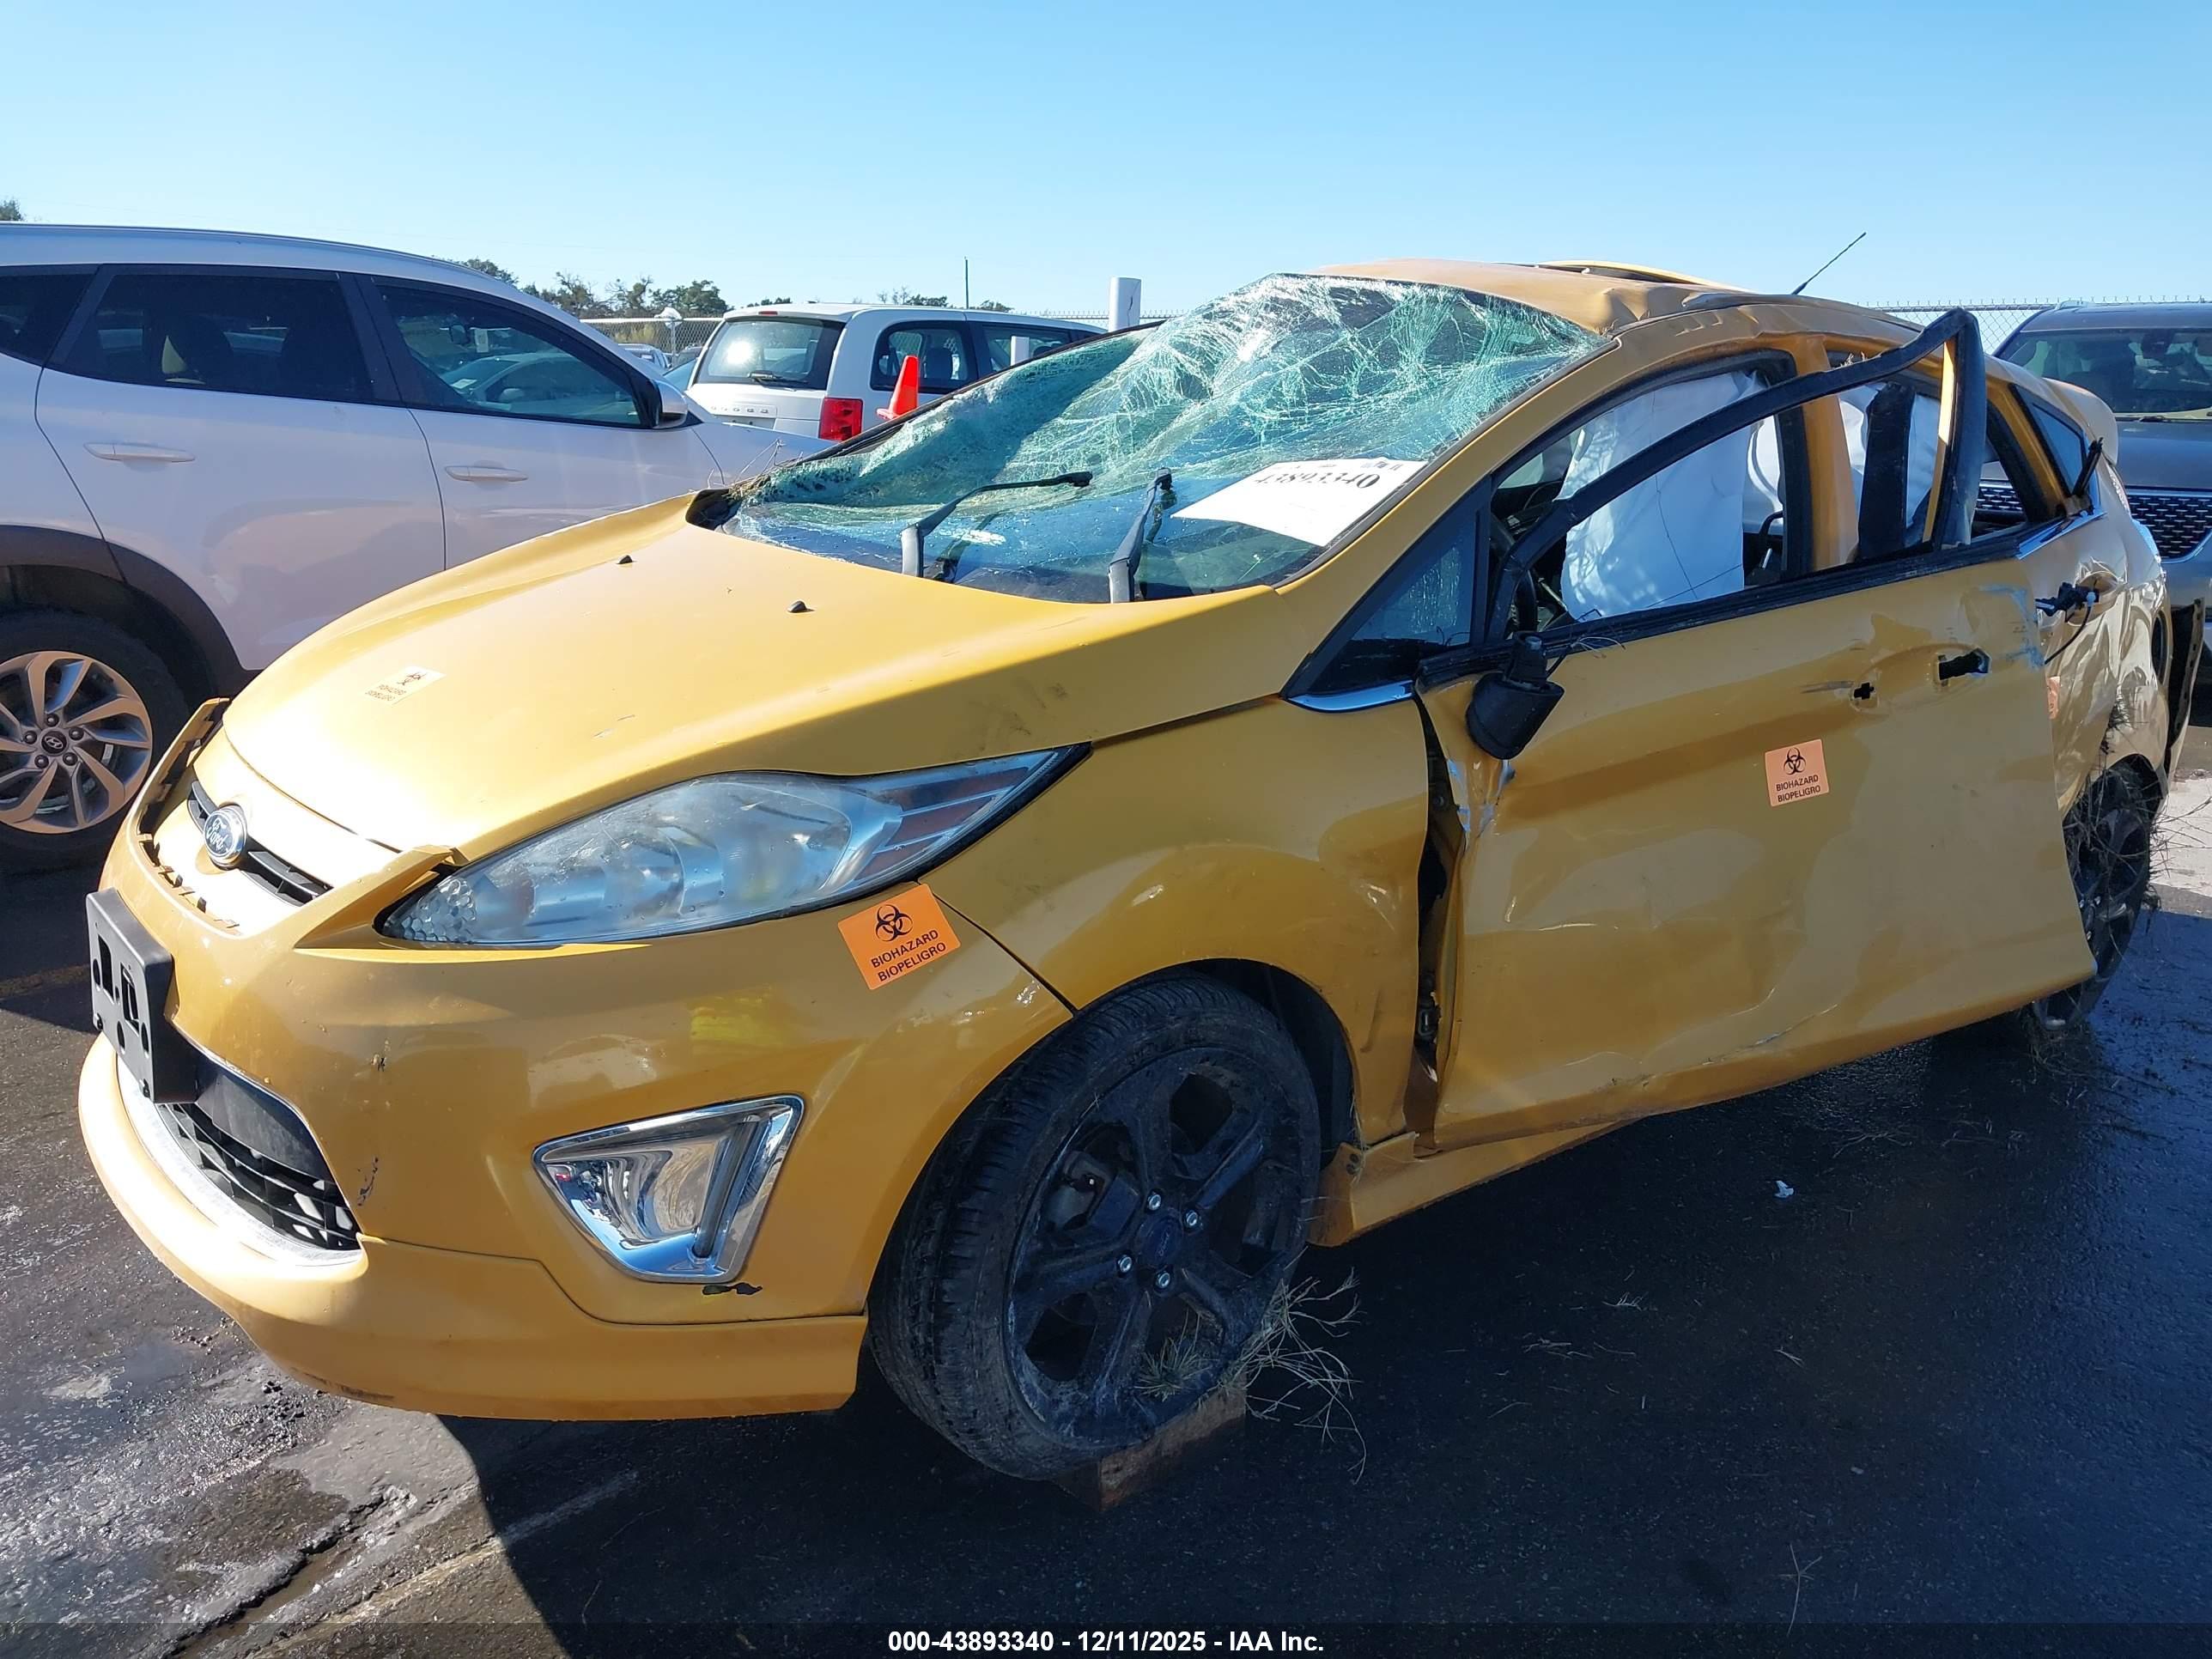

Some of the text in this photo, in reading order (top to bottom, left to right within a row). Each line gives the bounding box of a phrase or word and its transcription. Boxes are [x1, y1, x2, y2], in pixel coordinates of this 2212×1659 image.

[1776, 775, 1819, 792] BIOHAZARD
[1778, 785, 1821, 803] BIOPELIGRO
[871, 929, 939, 969] BIOHAZARD
[878, 942, 946, 982] BIOPELIGRO
